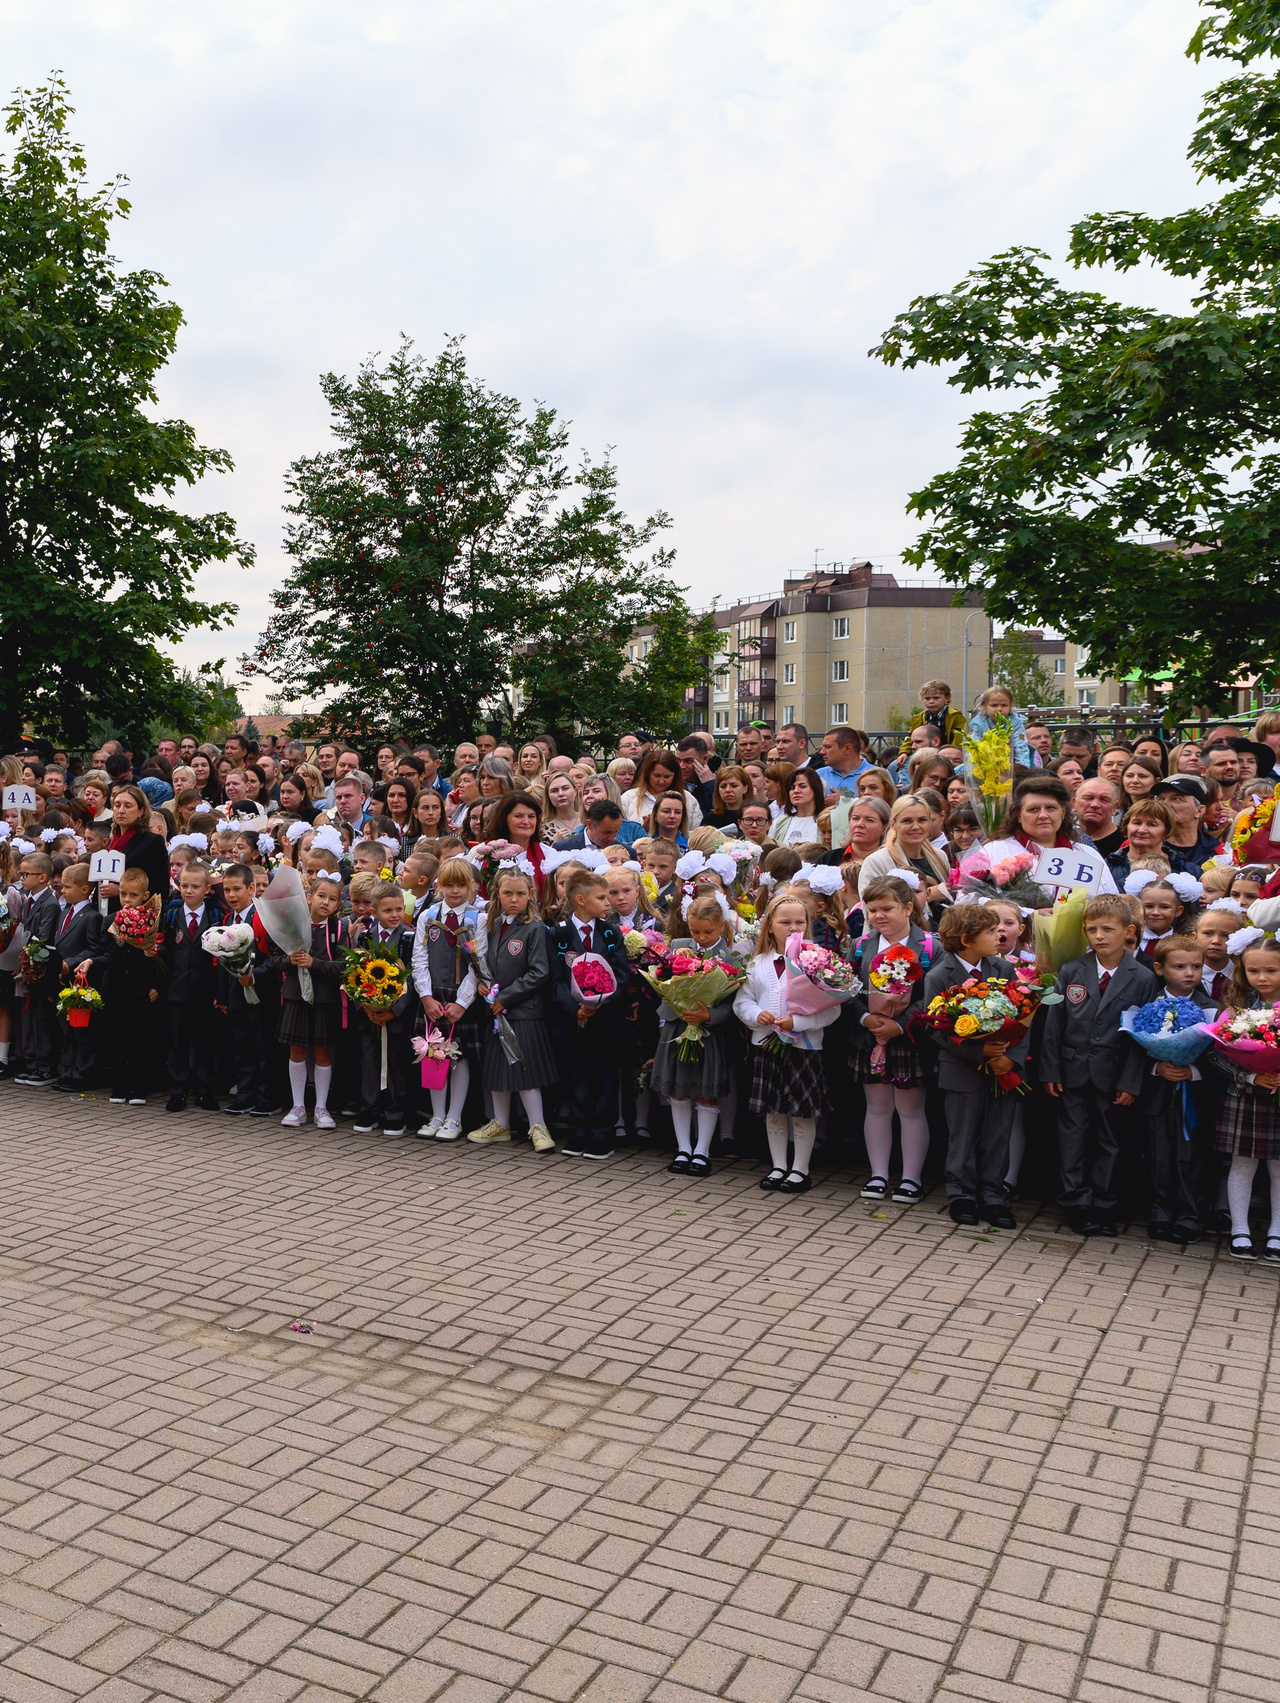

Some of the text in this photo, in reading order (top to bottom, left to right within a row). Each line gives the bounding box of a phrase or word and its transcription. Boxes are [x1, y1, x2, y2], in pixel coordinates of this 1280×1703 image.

[8, 791, 32, 803] 4 А
[96, 858, 121, 873] 1 Г
[1047, 857, 1094, 883] 3 Б
